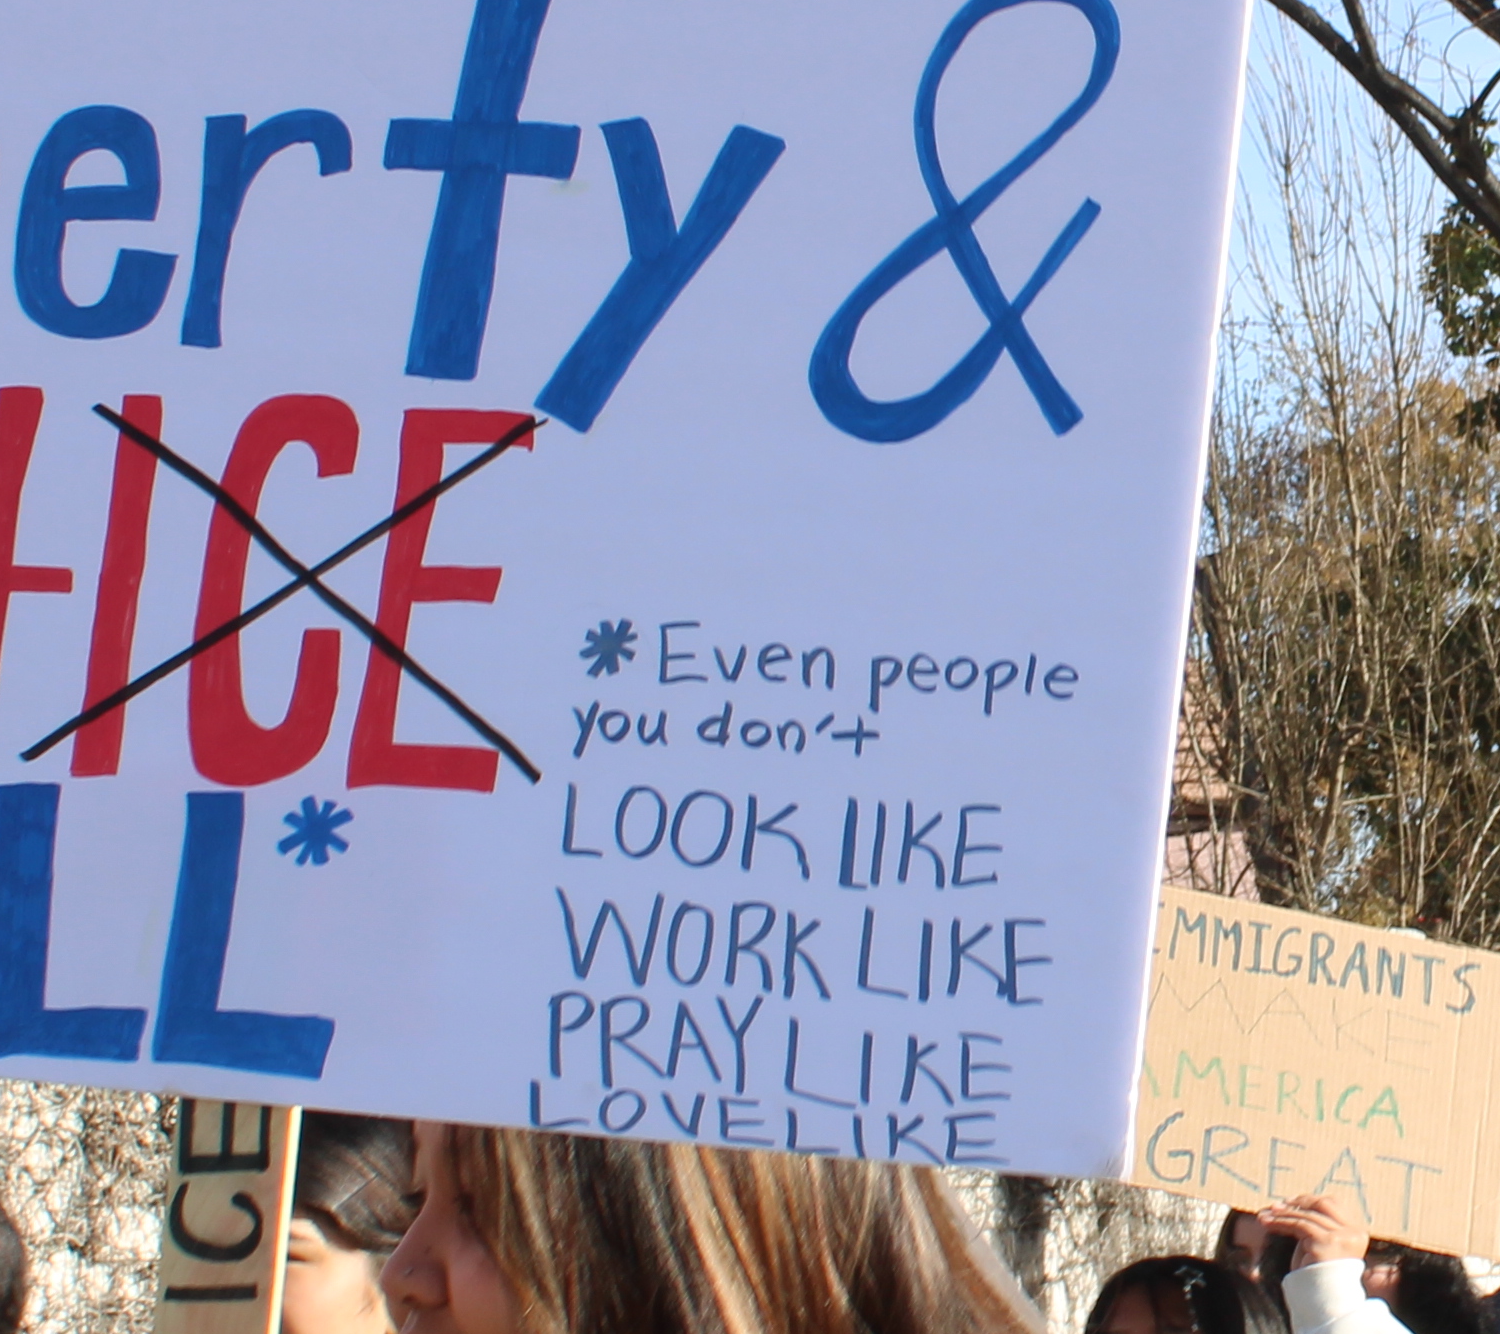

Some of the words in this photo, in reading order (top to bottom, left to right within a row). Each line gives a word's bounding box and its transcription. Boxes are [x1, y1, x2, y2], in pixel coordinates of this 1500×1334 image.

[572, 700, 668, 758] you
[697, 702, 880, 757] don't
[868, 652, 1081, 717] people
[562, 783, 810, 881] LOOK
[838, 796, 1004, 890] LIKE
[555, 886, 831, 1001] WORK
[857, 906, 1054, 1006] LIKE
[1151, 900, 1482, 1015] MMIGRANTS
[546, 991, 765, 1095] PRAY
[784, 1015, 1011, 1107] LIKE
[529, 1079, 775, 1146] LOVE
[786, 1107, 1011, 1166] LIKE
[1146, 1111, 1443, 1233] GREAT
[162, 1098, 272, 1303] ICE
